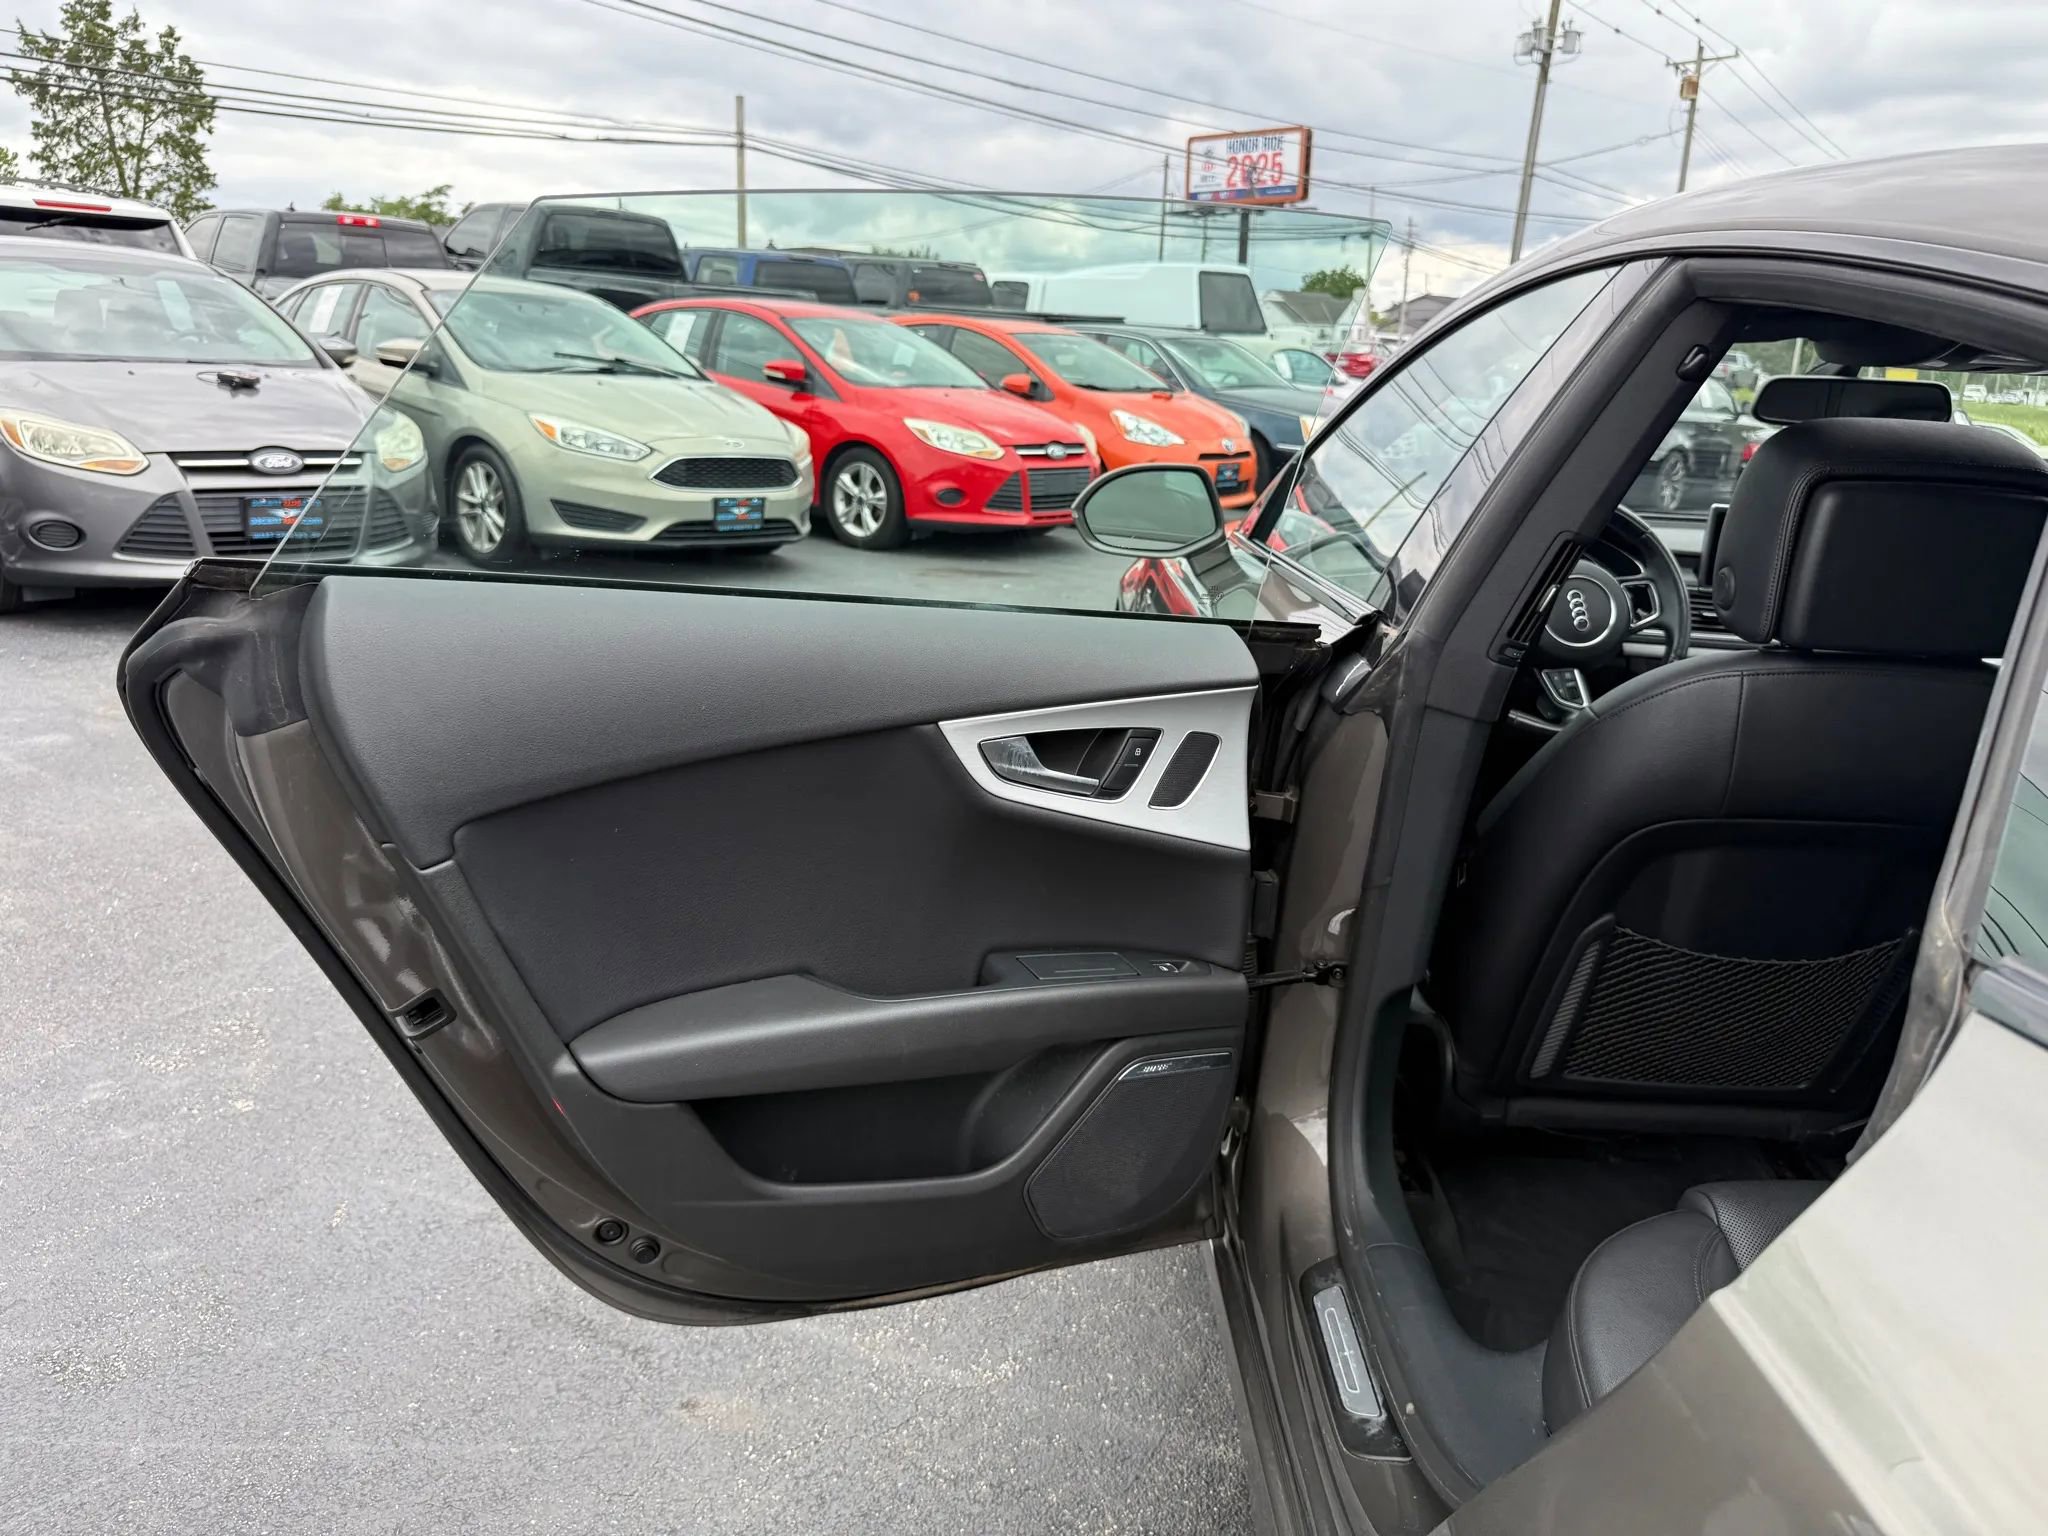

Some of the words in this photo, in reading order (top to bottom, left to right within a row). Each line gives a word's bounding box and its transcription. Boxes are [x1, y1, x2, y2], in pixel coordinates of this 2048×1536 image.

[1226, 137, 1258, 153] HONOR
[1226, 152, 1283, 188] 2025
[263, 456, 293, 468] Ford
